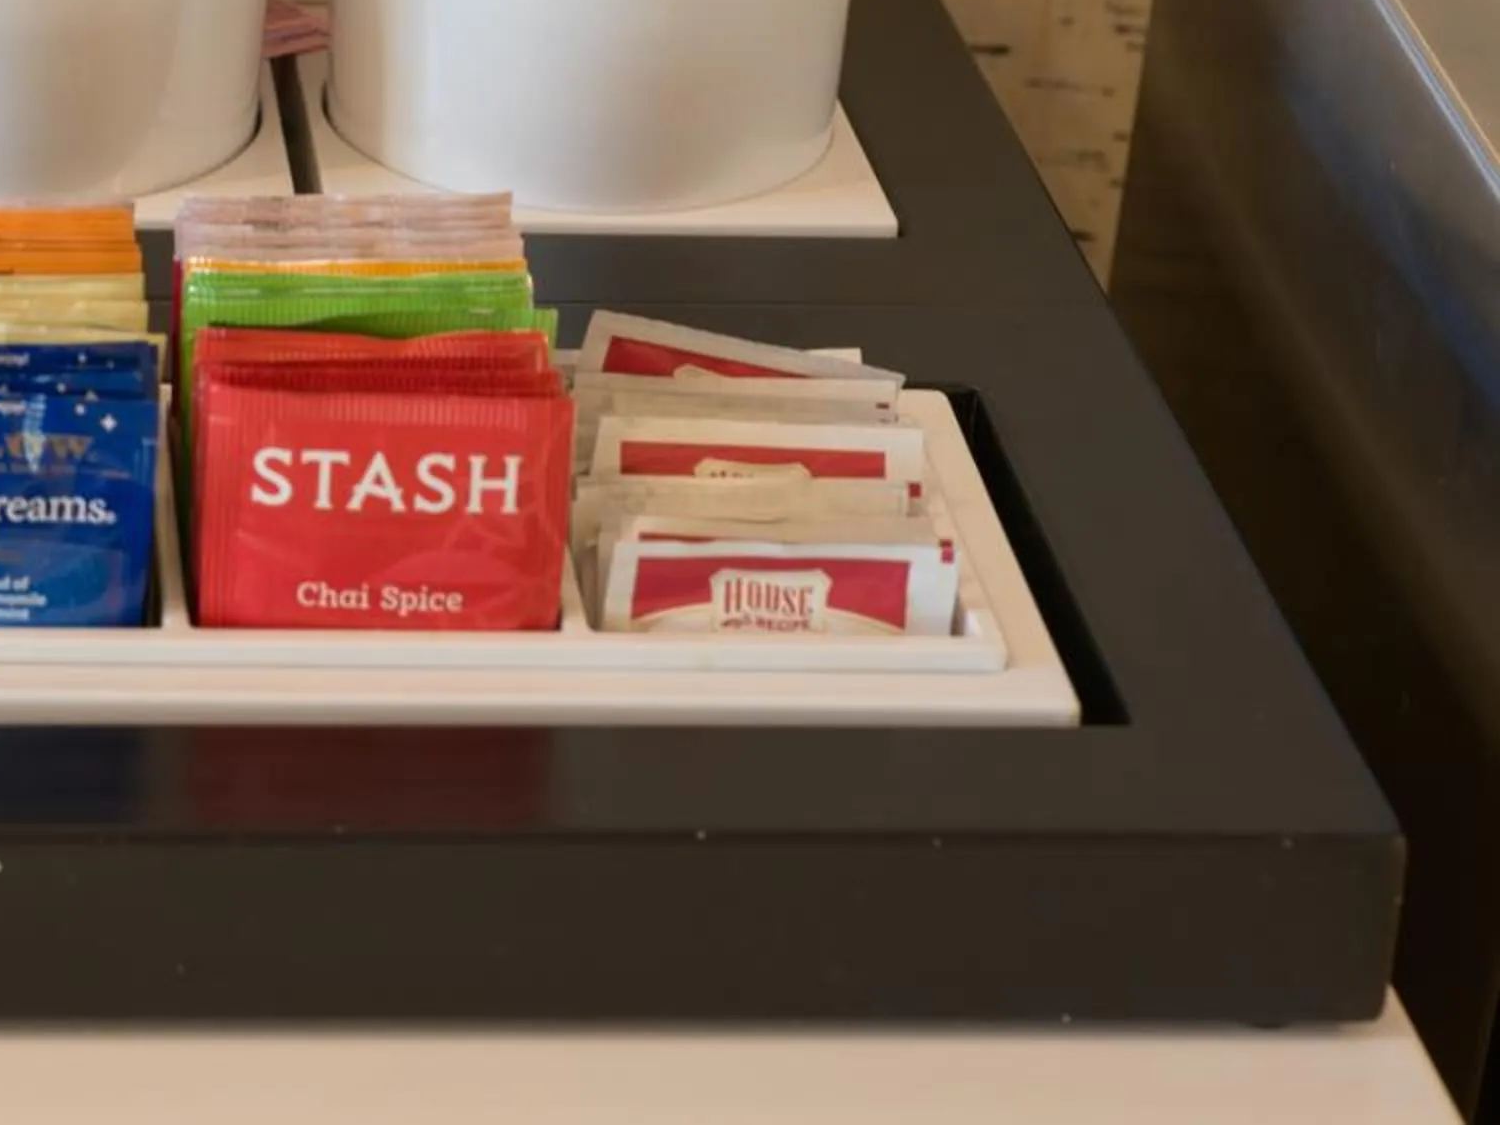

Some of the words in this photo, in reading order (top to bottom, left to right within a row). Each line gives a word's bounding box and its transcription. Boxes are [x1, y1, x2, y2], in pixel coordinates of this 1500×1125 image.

[250, 447, 522, 515] STASH
[297, 581, 369, 610] Chai
[380, 585, 463, 616] Spice
[725, 576, 813, 617] HOUSE
